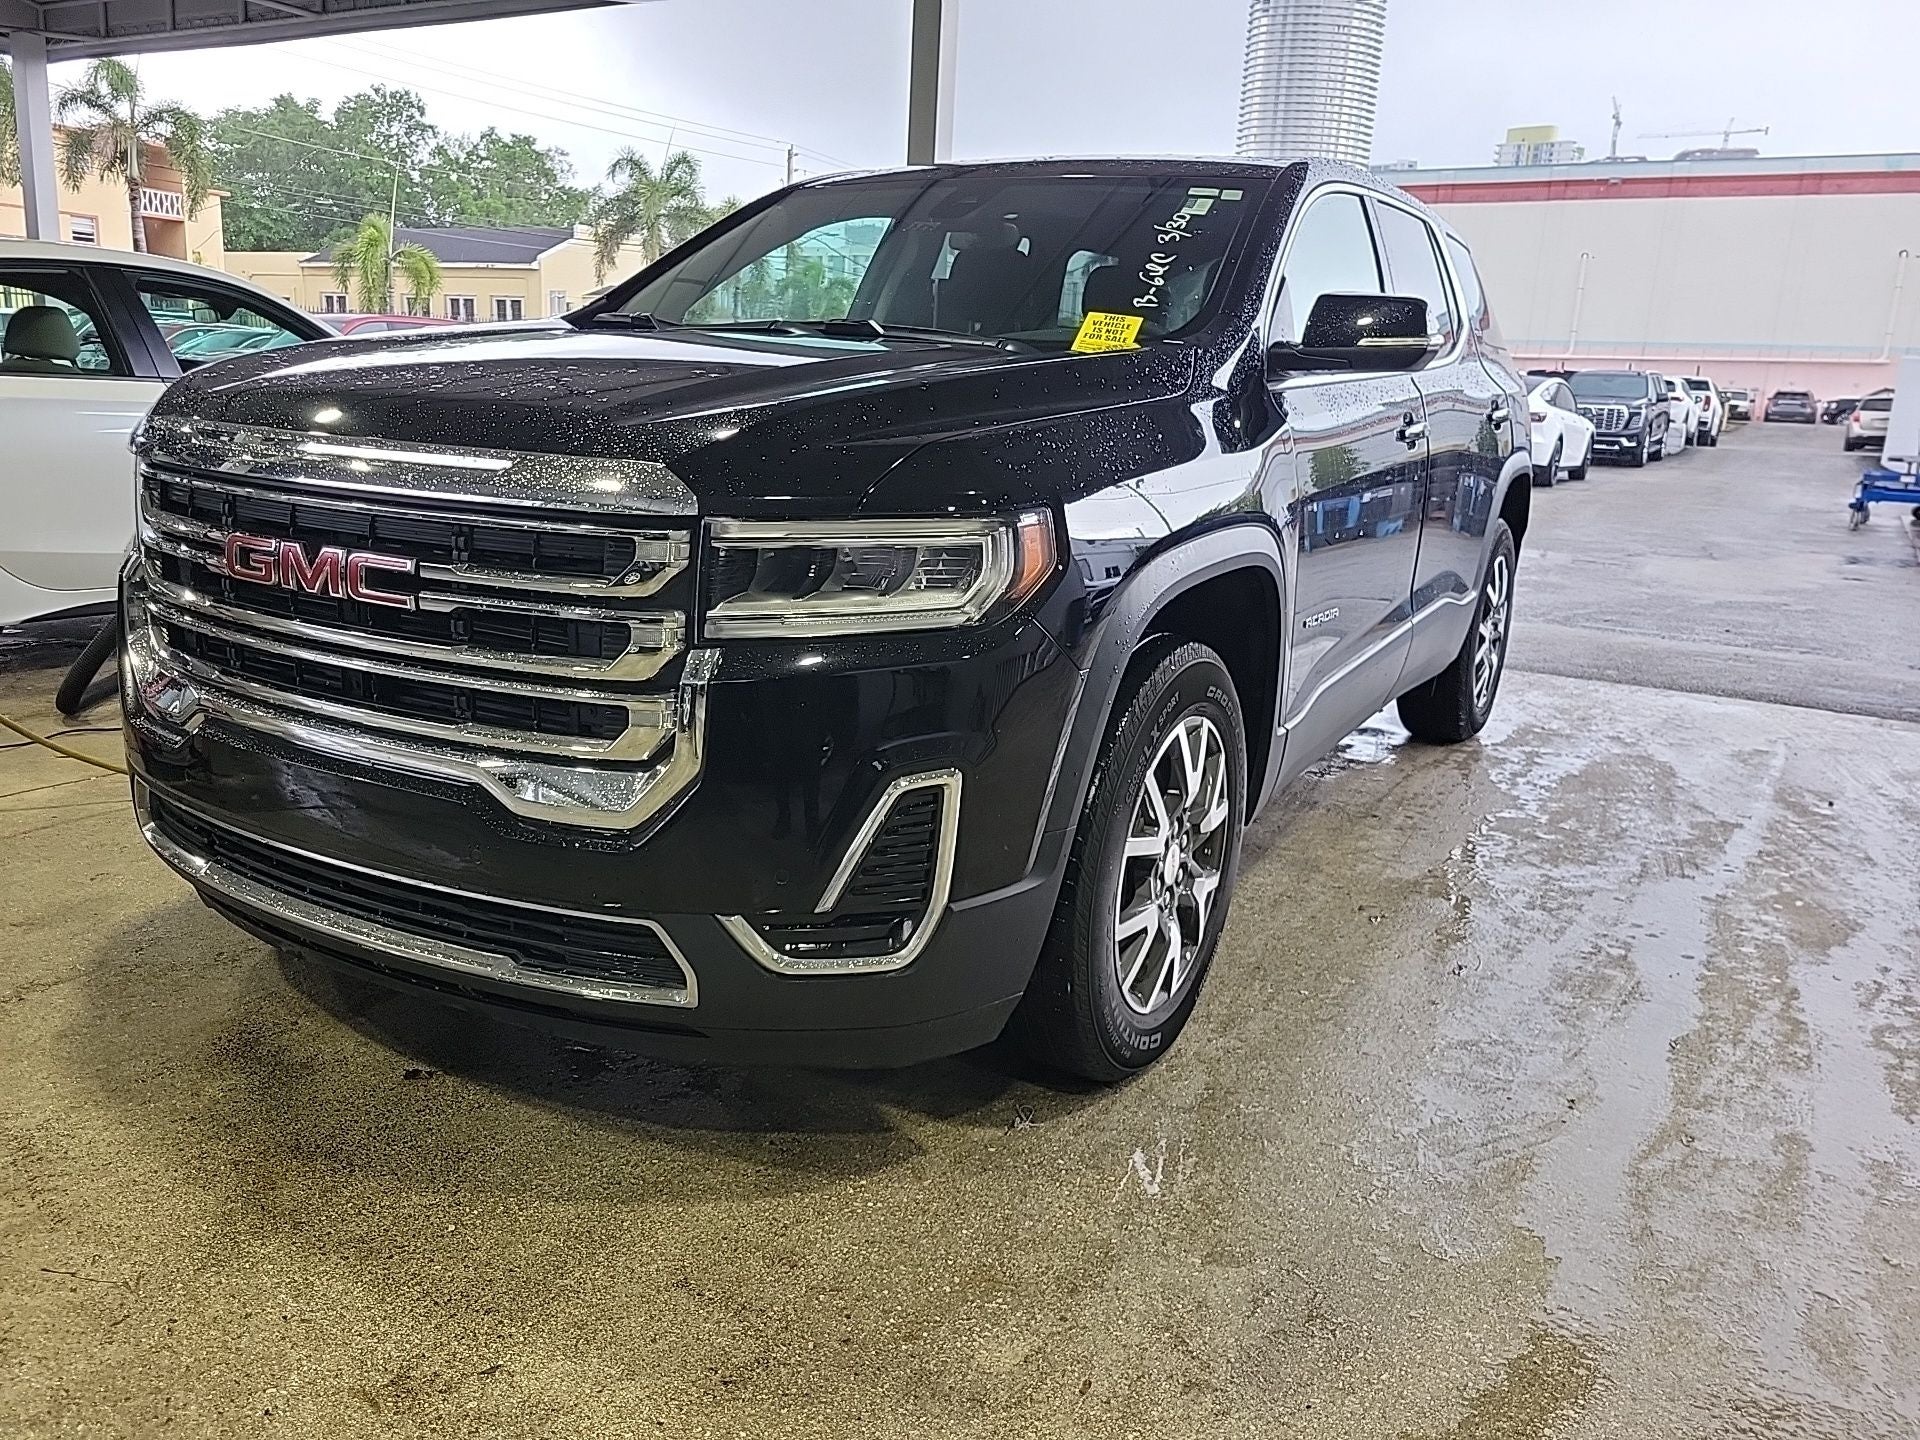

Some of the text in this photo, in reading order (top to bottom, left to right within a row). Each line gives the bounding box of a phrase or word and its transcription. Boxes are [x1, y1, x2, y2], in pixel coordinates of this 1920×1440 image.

[1153, 212, 1192, 243] 3/30
[1092, 320, 1132, 330] VEHICLE
[1104, 314, 1126, 322] THIS
[1083, 332, 1128, 344] FOR SALE
[1105, 328, 1125, 336] NOT
[225, 532, 417, 612] GMC
[1304, 607, 1339, 628] ACADIA
[1158, 690, 1180, 727] SPORT
